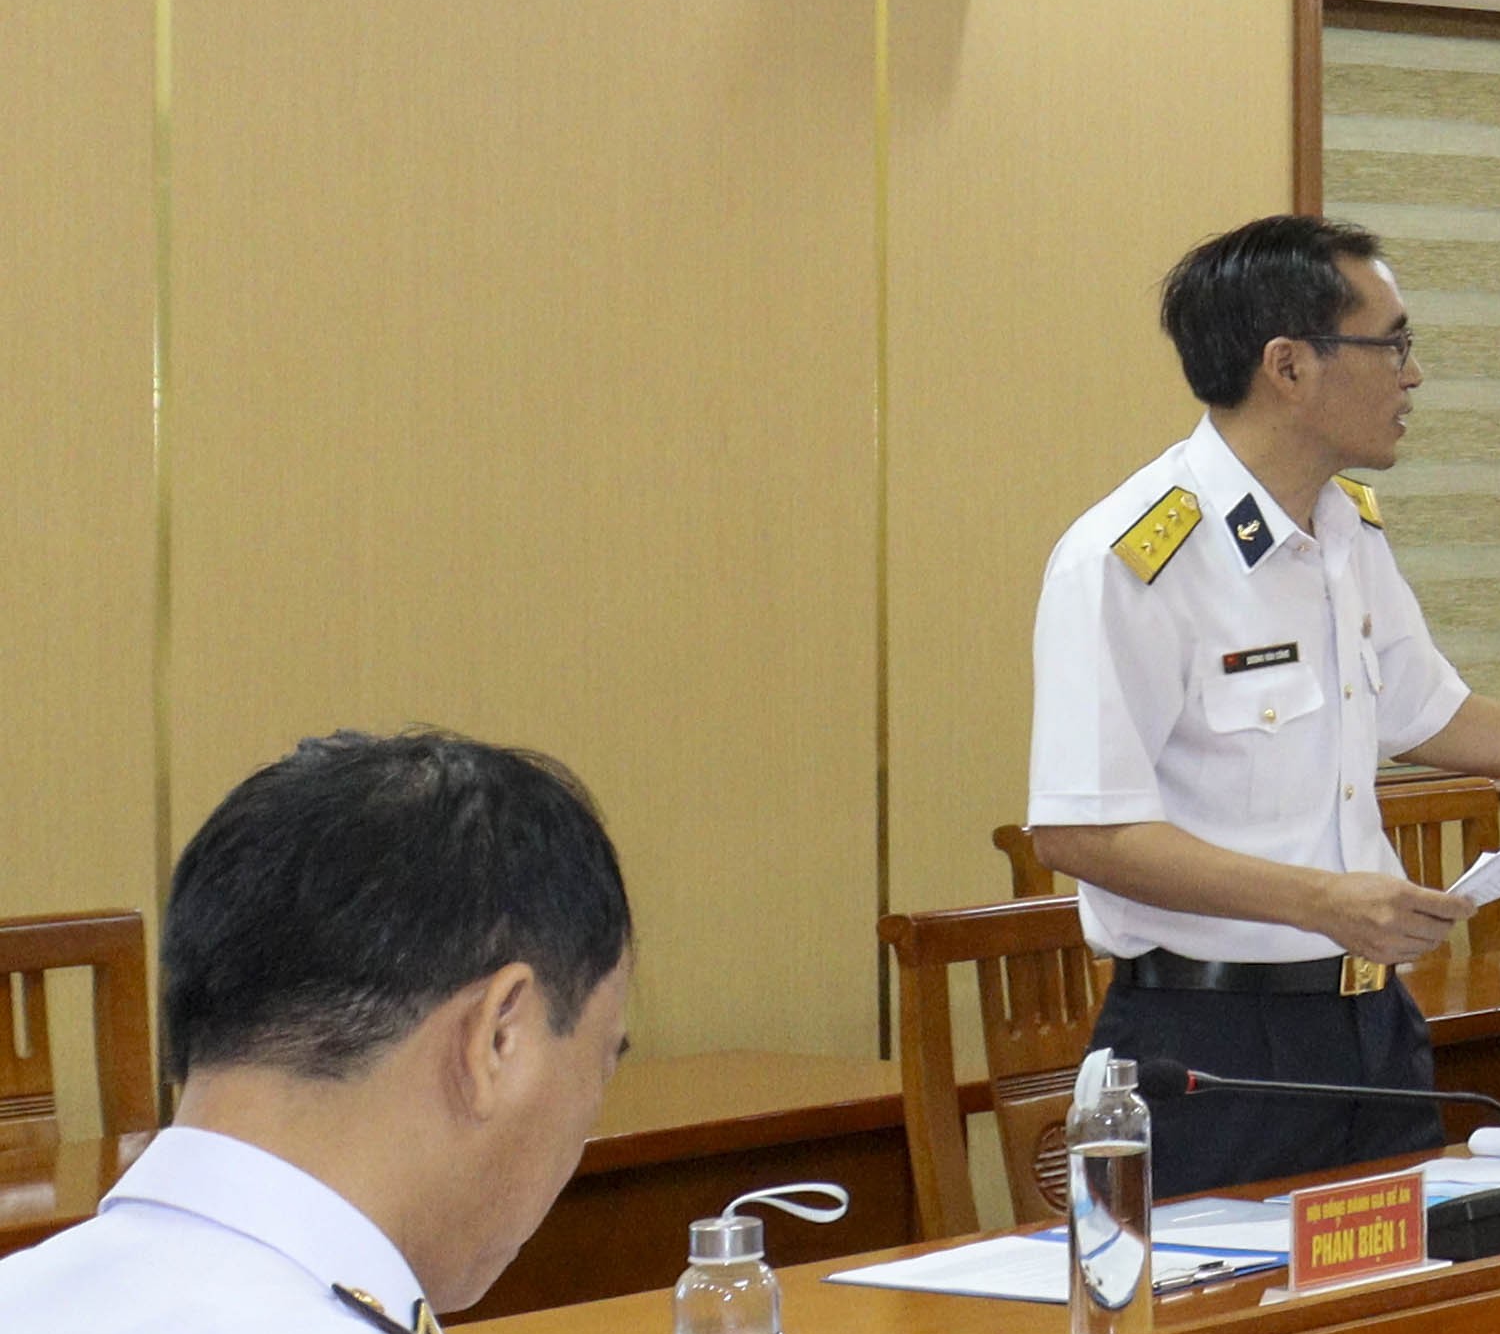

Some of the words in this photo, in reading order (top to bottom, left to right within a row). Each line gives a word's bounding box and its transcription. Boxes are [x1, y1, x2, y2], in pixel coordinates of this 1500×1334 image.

[1311, 1216, 1354, 1268] PHẢN
[1358, 1215, 1394, 1262] BIỆN
[1398, 1218, 1406, 1250] 1
